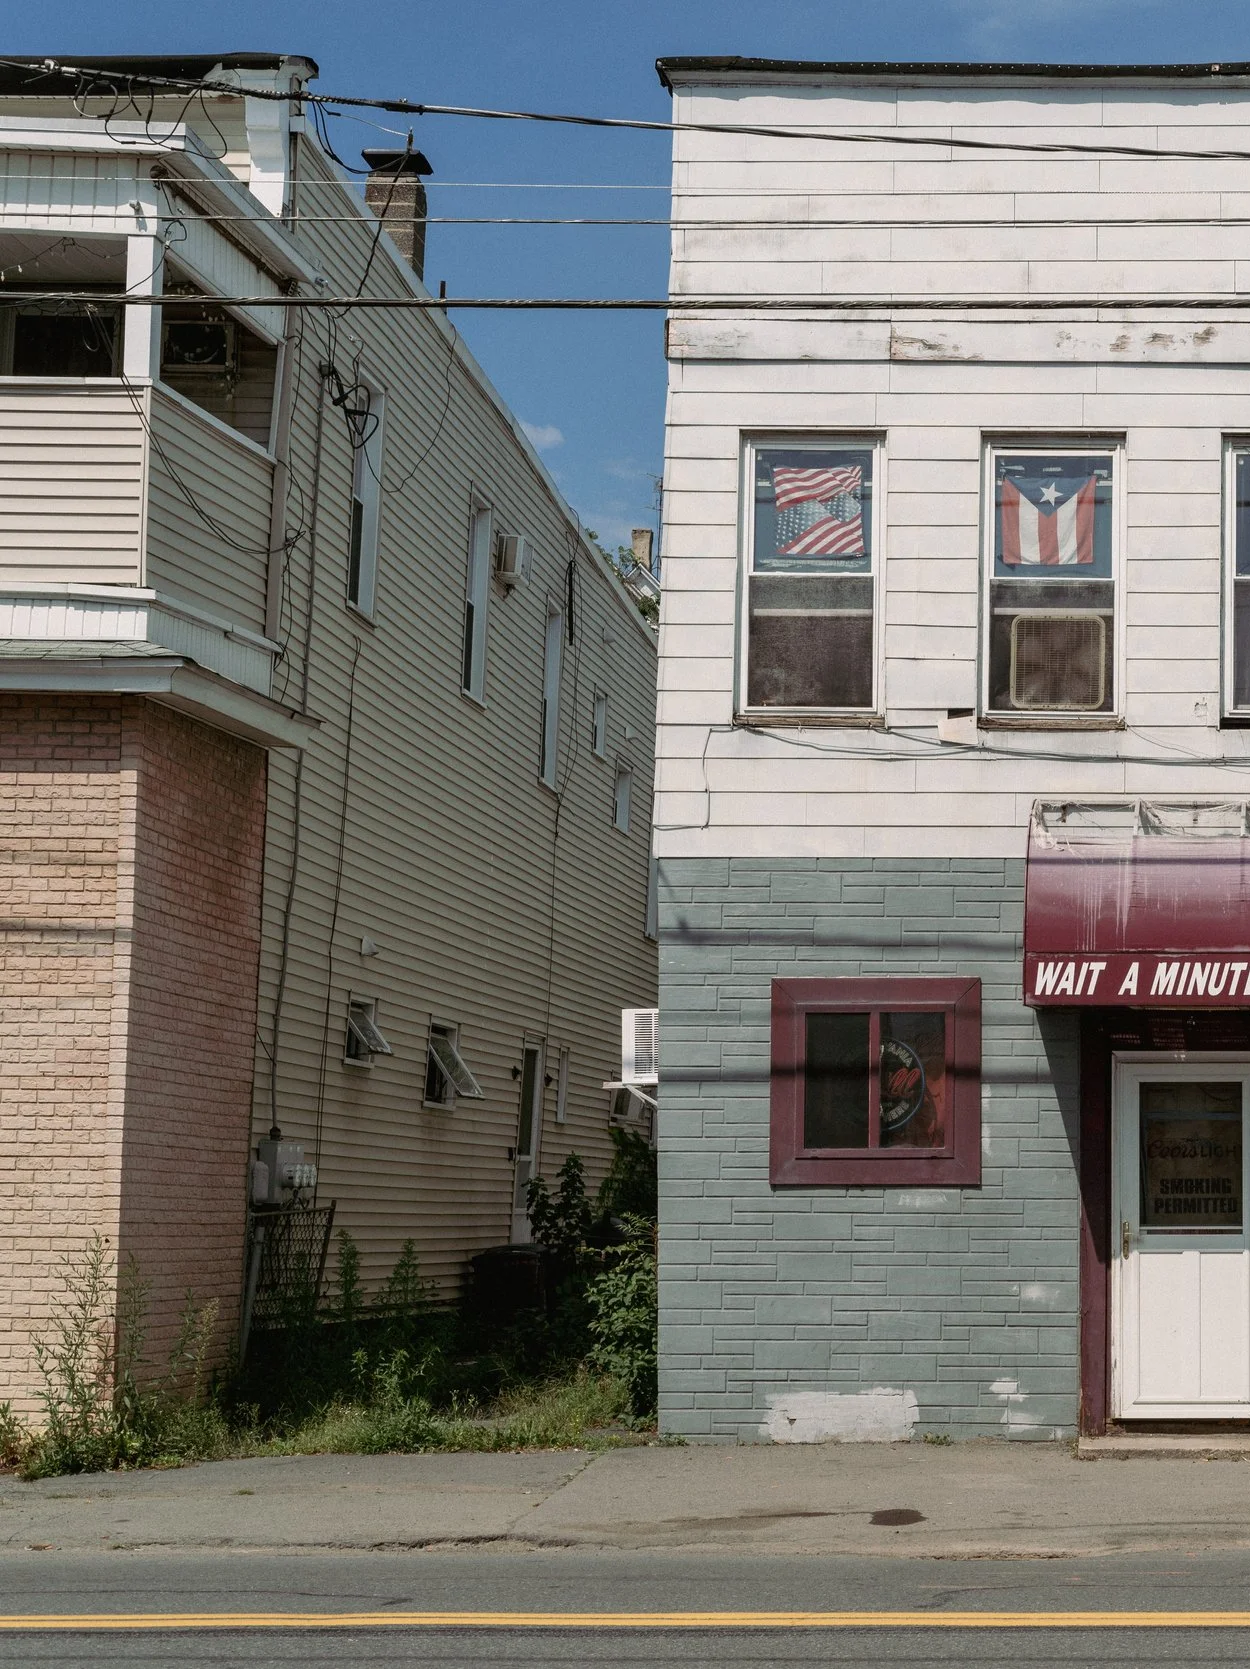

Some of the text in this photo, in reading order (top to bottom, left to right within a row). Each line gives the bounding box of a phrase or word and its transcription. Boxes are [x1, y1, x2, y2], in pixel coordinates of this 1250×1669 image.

[1034, 961, 1107, 996] WAIT
[1117, 961, 1140, 996] A
[1159, 1177, 1232, 1195] SMOKING
[1153, 1197, 1238, 1214] PERMITTED
